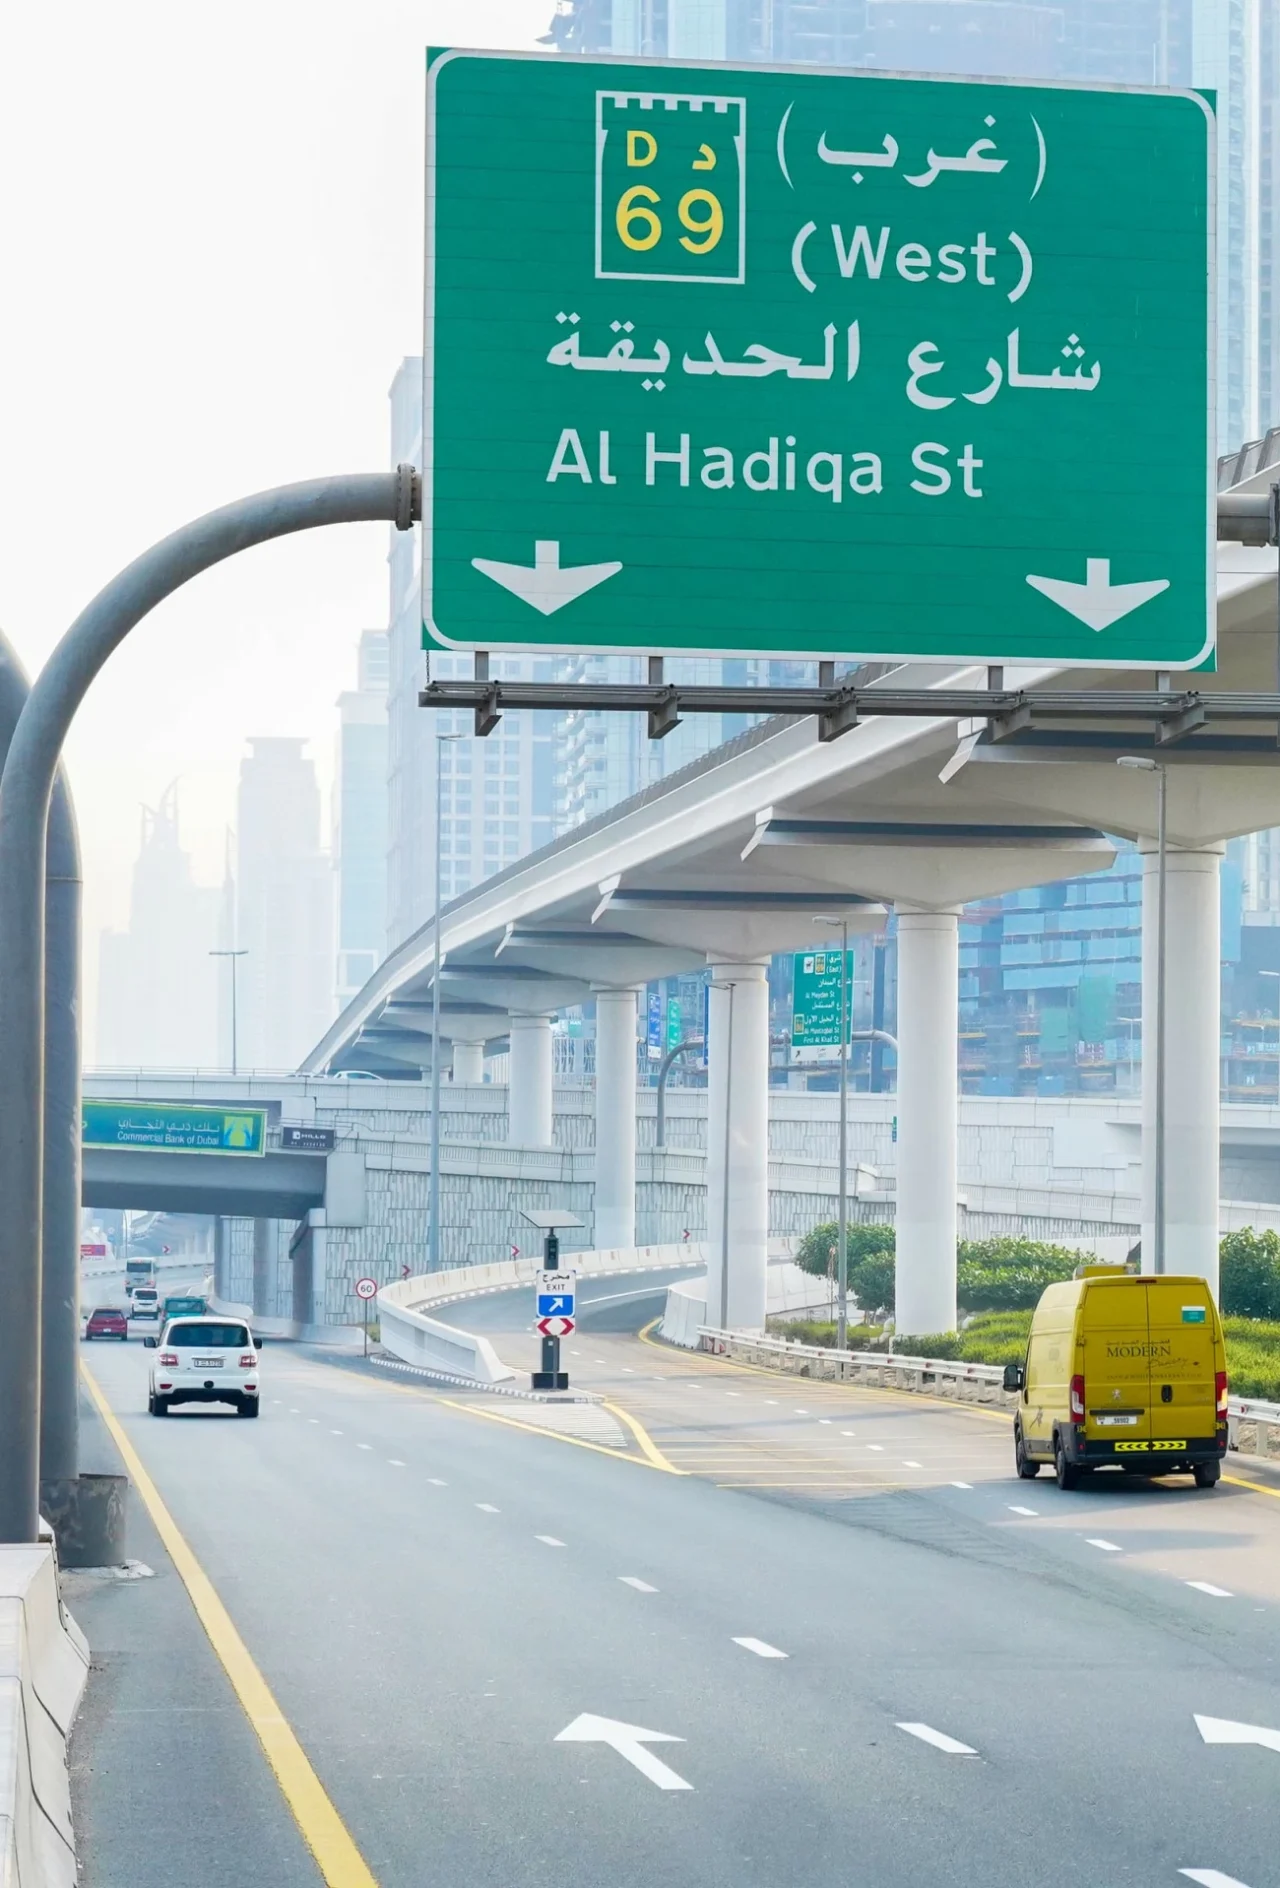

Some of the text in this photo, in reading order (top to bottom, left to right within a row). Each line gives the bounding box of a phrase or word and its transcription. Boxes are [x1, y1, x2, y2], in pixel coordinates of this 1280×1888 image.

[627, 131, 657, 166] D
[693, 144, 716, 170] د
[616, 185, 723, 254] 69
[792, 222, 1032, 302] (West)
[547, 312, 1100, 409] شارع الحديقة
[547, 429, 983, 502] Al Hadiqa St
[117, 1131, 220, 1145] Commercial Bank of Dubai
[360, 1284, 372, 1293] 60
[546, 1283, 565, 1291] EXIT
[1106, 1346, 1171, 1358] MODERN
